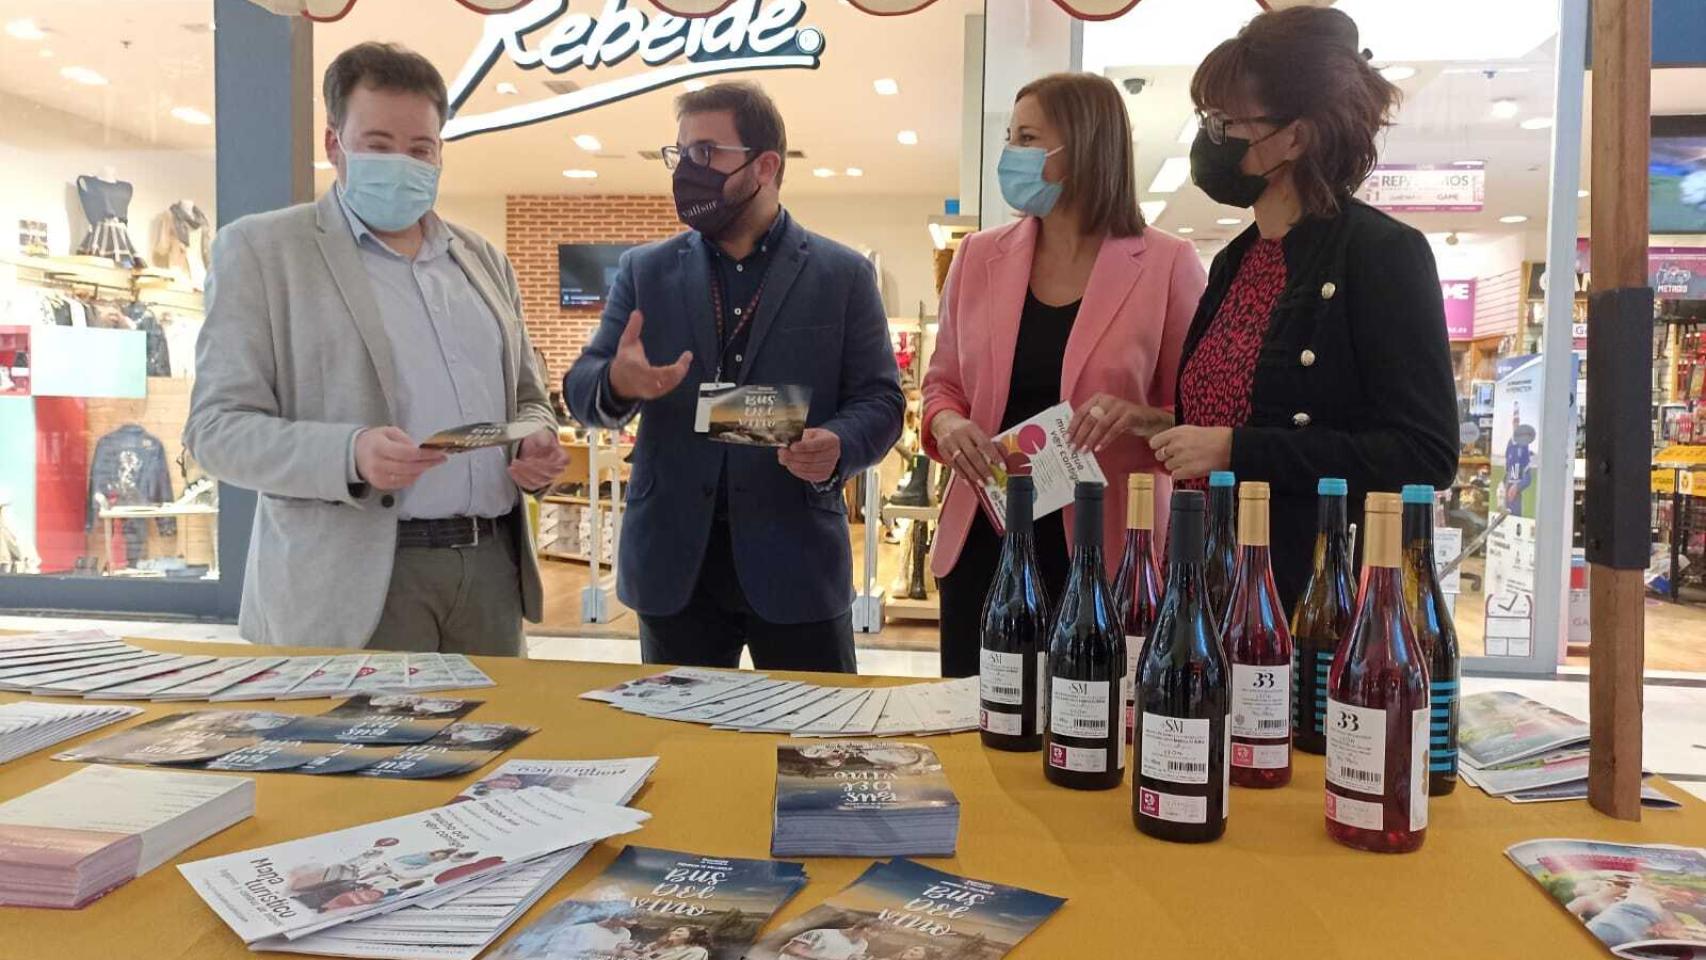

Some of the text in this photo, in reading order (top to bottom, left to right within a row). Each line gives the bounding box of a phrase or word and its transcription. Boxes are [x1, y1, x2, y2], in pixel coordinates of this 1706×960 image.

[1253, 672, 1275, 688] 33
[1337, 711, 1360, 732] 33
[250, 858, 285, 885] Mapa
[245, 877, 297, 919] turístico
